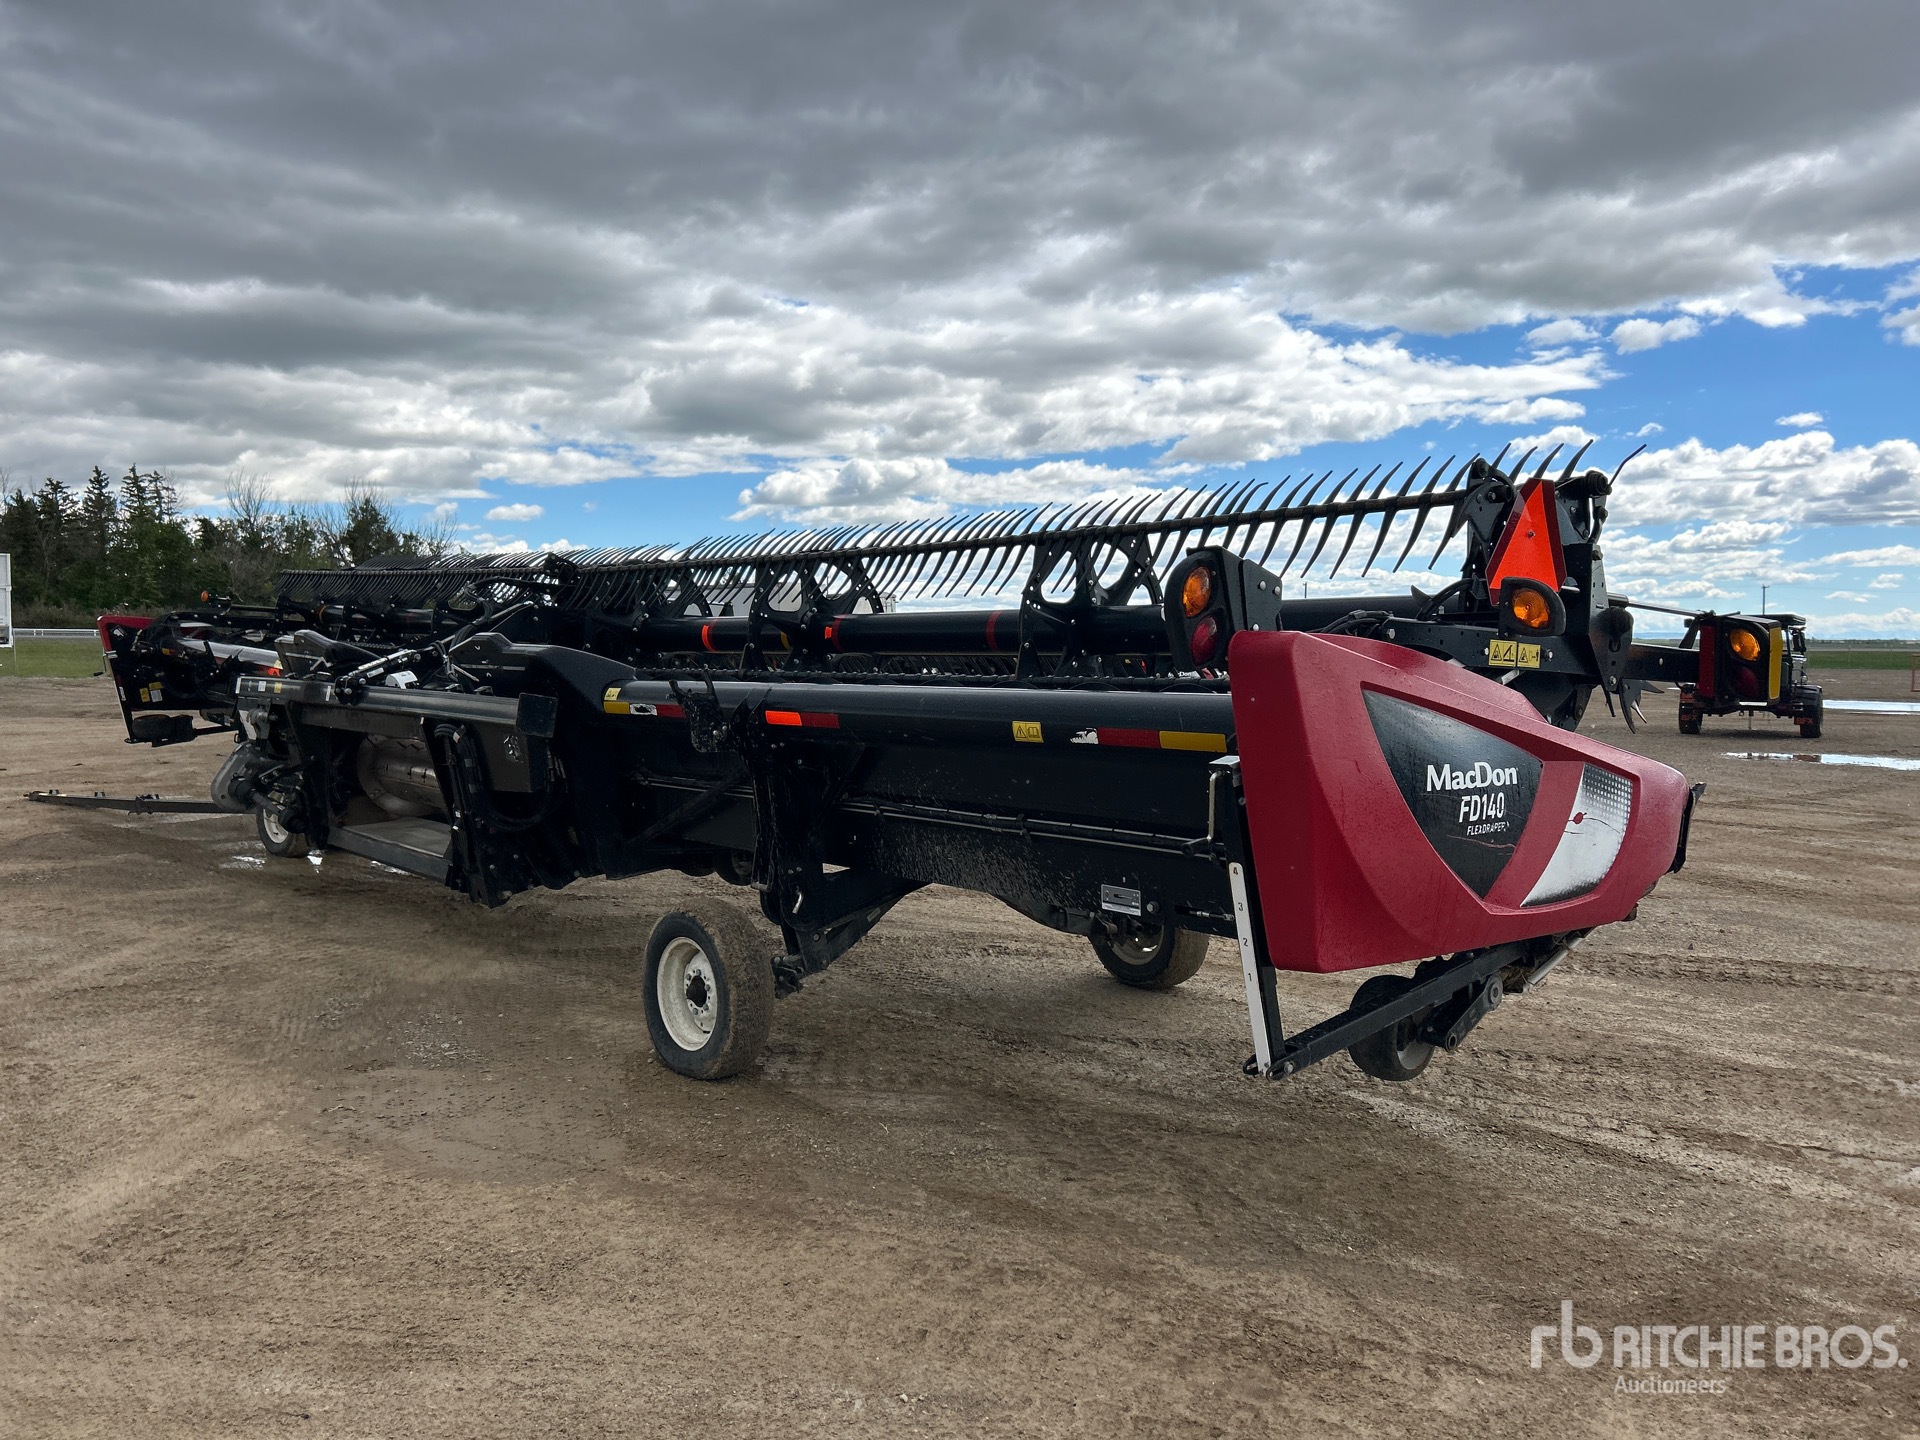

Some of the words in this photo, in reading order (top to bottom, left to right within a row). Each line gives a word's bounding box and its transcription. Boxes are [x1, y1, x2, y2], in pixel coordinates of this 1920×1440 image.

[1426, 761, 1518, 792] MacDon
[1459, 792, 1505, 823] FD140
[1233, 866, 1239, 876] 4
[1237, 901, 1244, 911] 3
[1242, 937, 1249, 947] 2
[1247, 972, 1252, 982] 1
